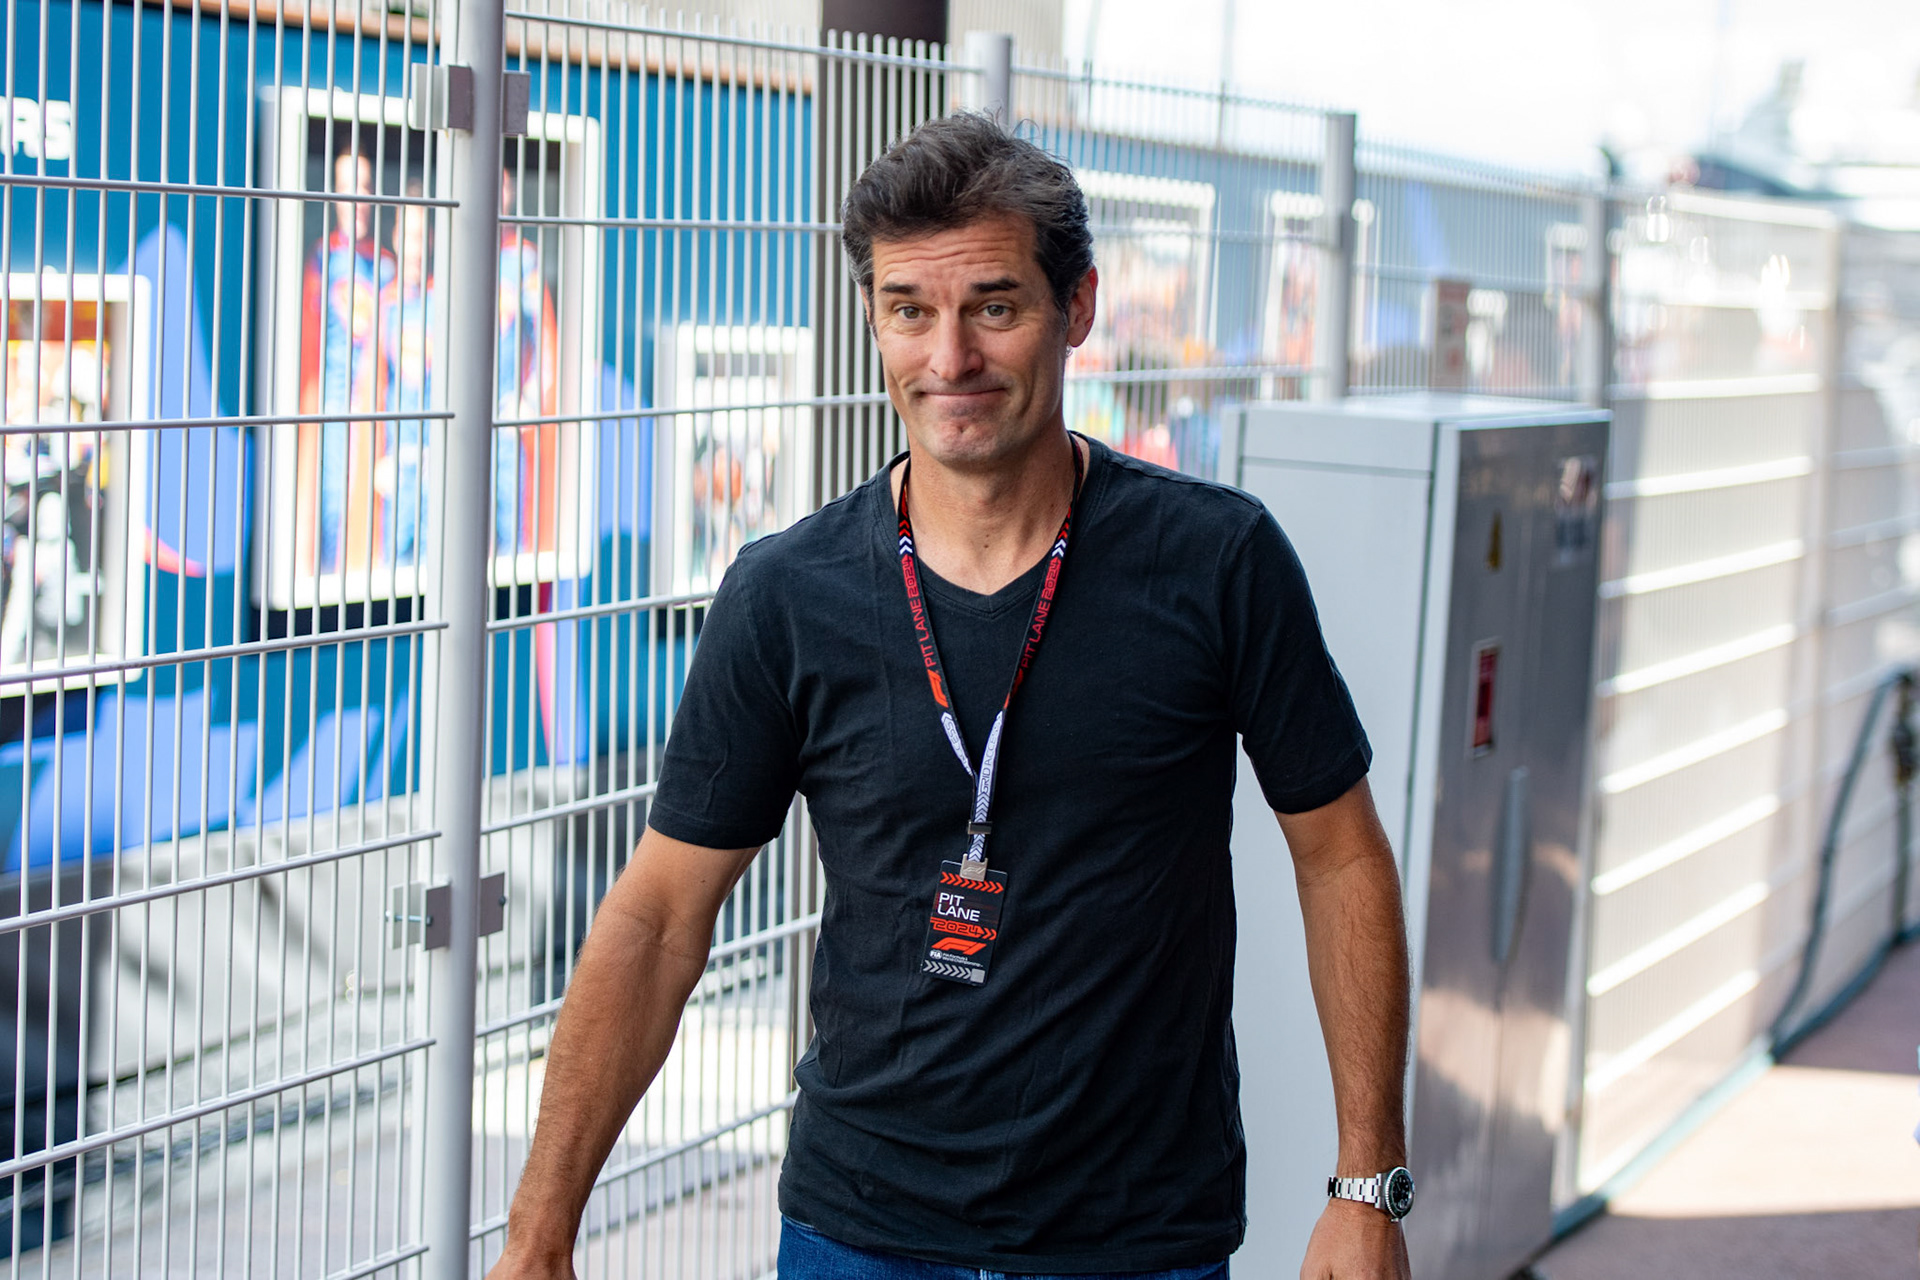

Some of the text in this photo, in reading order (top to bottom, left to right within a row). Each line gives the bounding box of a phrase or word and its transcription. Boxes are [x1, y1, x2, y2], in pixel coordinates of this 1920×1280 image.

[902, 555, 937, 667] PIT LANE 2024
[1020, 557, 1062, 668] PIT LANE 2024
[938, 892, 965, 906] PIT
[936, 903, 981, 922] LANE
[935, 921, 981, 936] 2024
